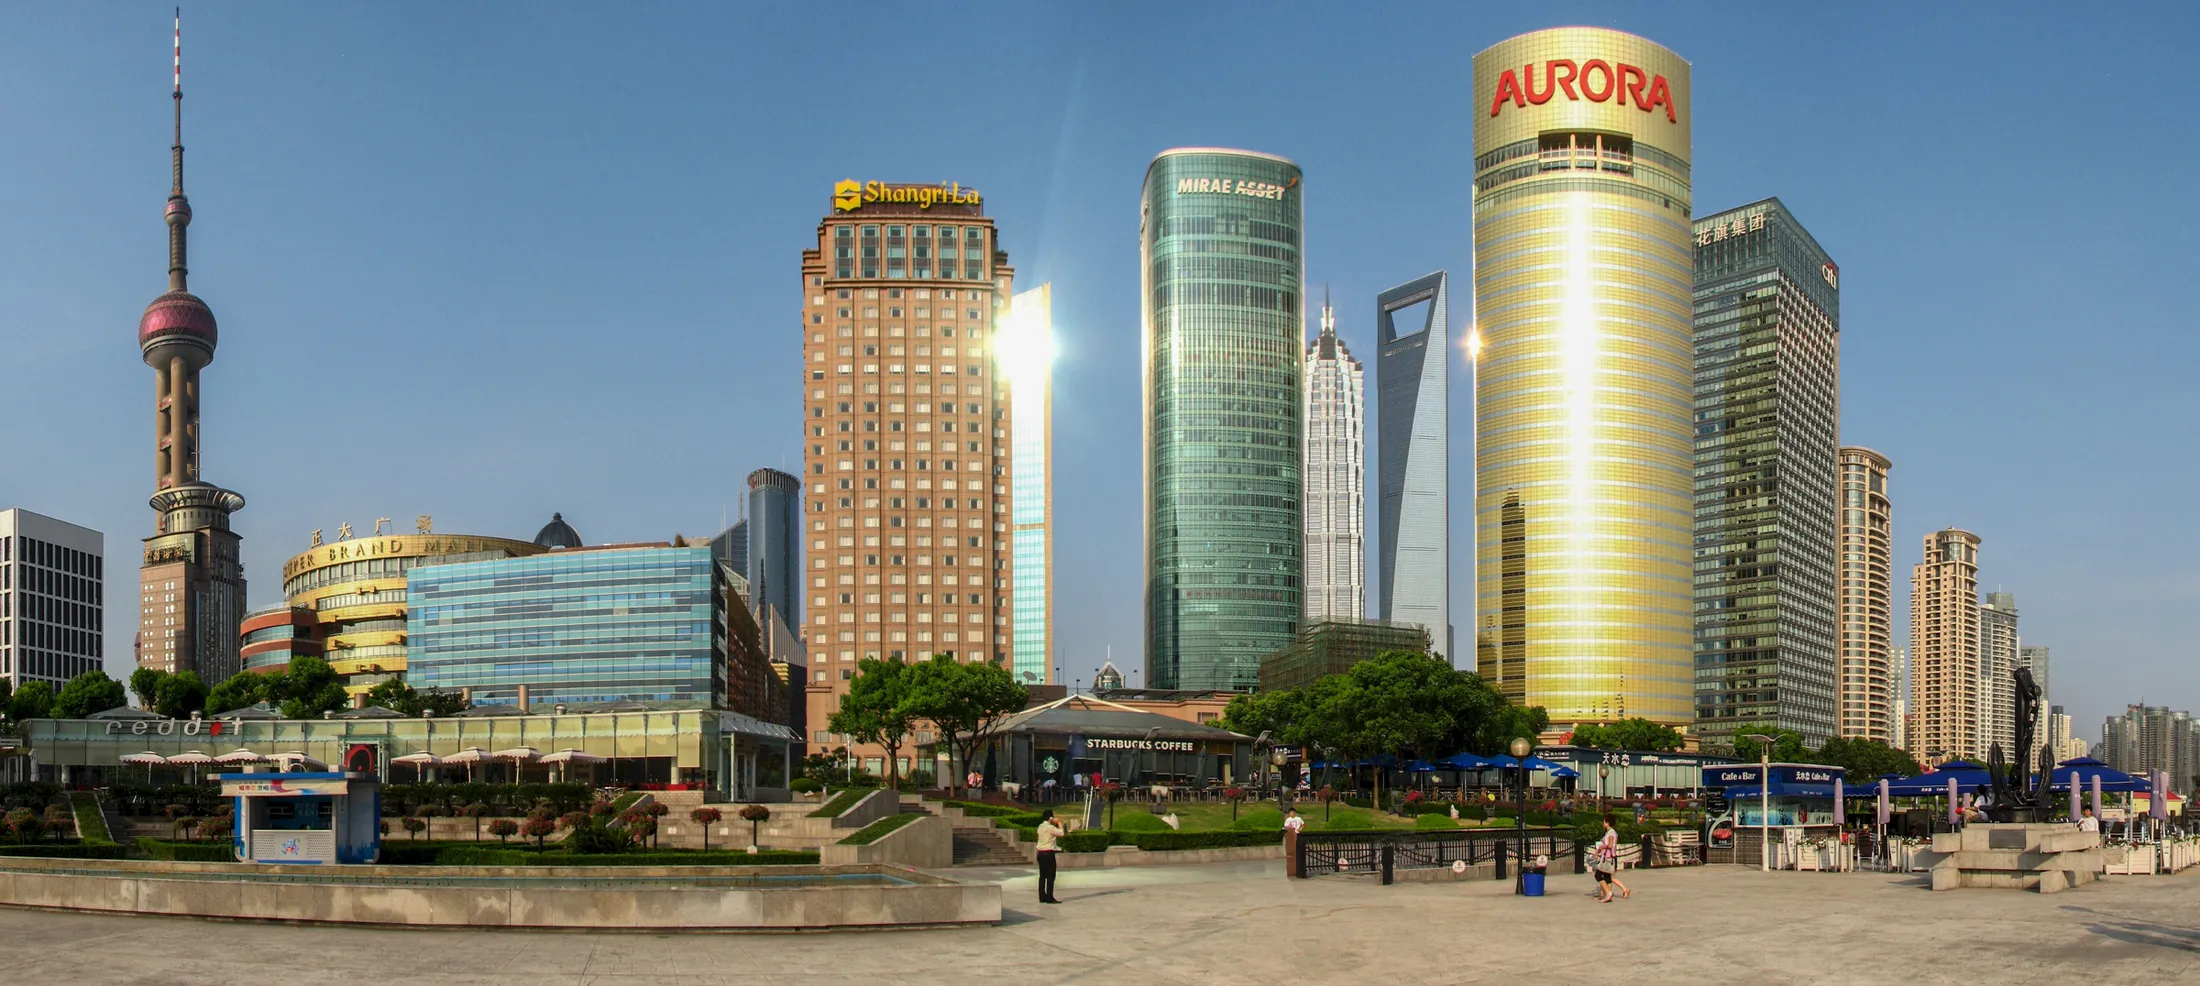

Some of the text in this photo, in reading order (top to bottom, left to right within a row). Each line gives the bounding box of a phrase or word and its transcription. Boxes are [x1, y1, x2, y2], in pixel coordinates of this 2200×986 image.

[1491, 59, 1677, 124] AURORA
[864, 180, 979, 209] Shangri-La
[1177, 177, 1285, 201] MIRAE ASSET
[1696, 212, 1765, 248] 花旗集团
[311, 514, 433, 548] 正大广场
[284, 554, 315, 578] SUPER
[329, 539, 403, 561] BRAND
[1087, 739, 1194, 751] STARBUCKS COFFEE
[1721, 772, 1738, 781] Cafe
[1742, 772, 1757, 780] Bar
